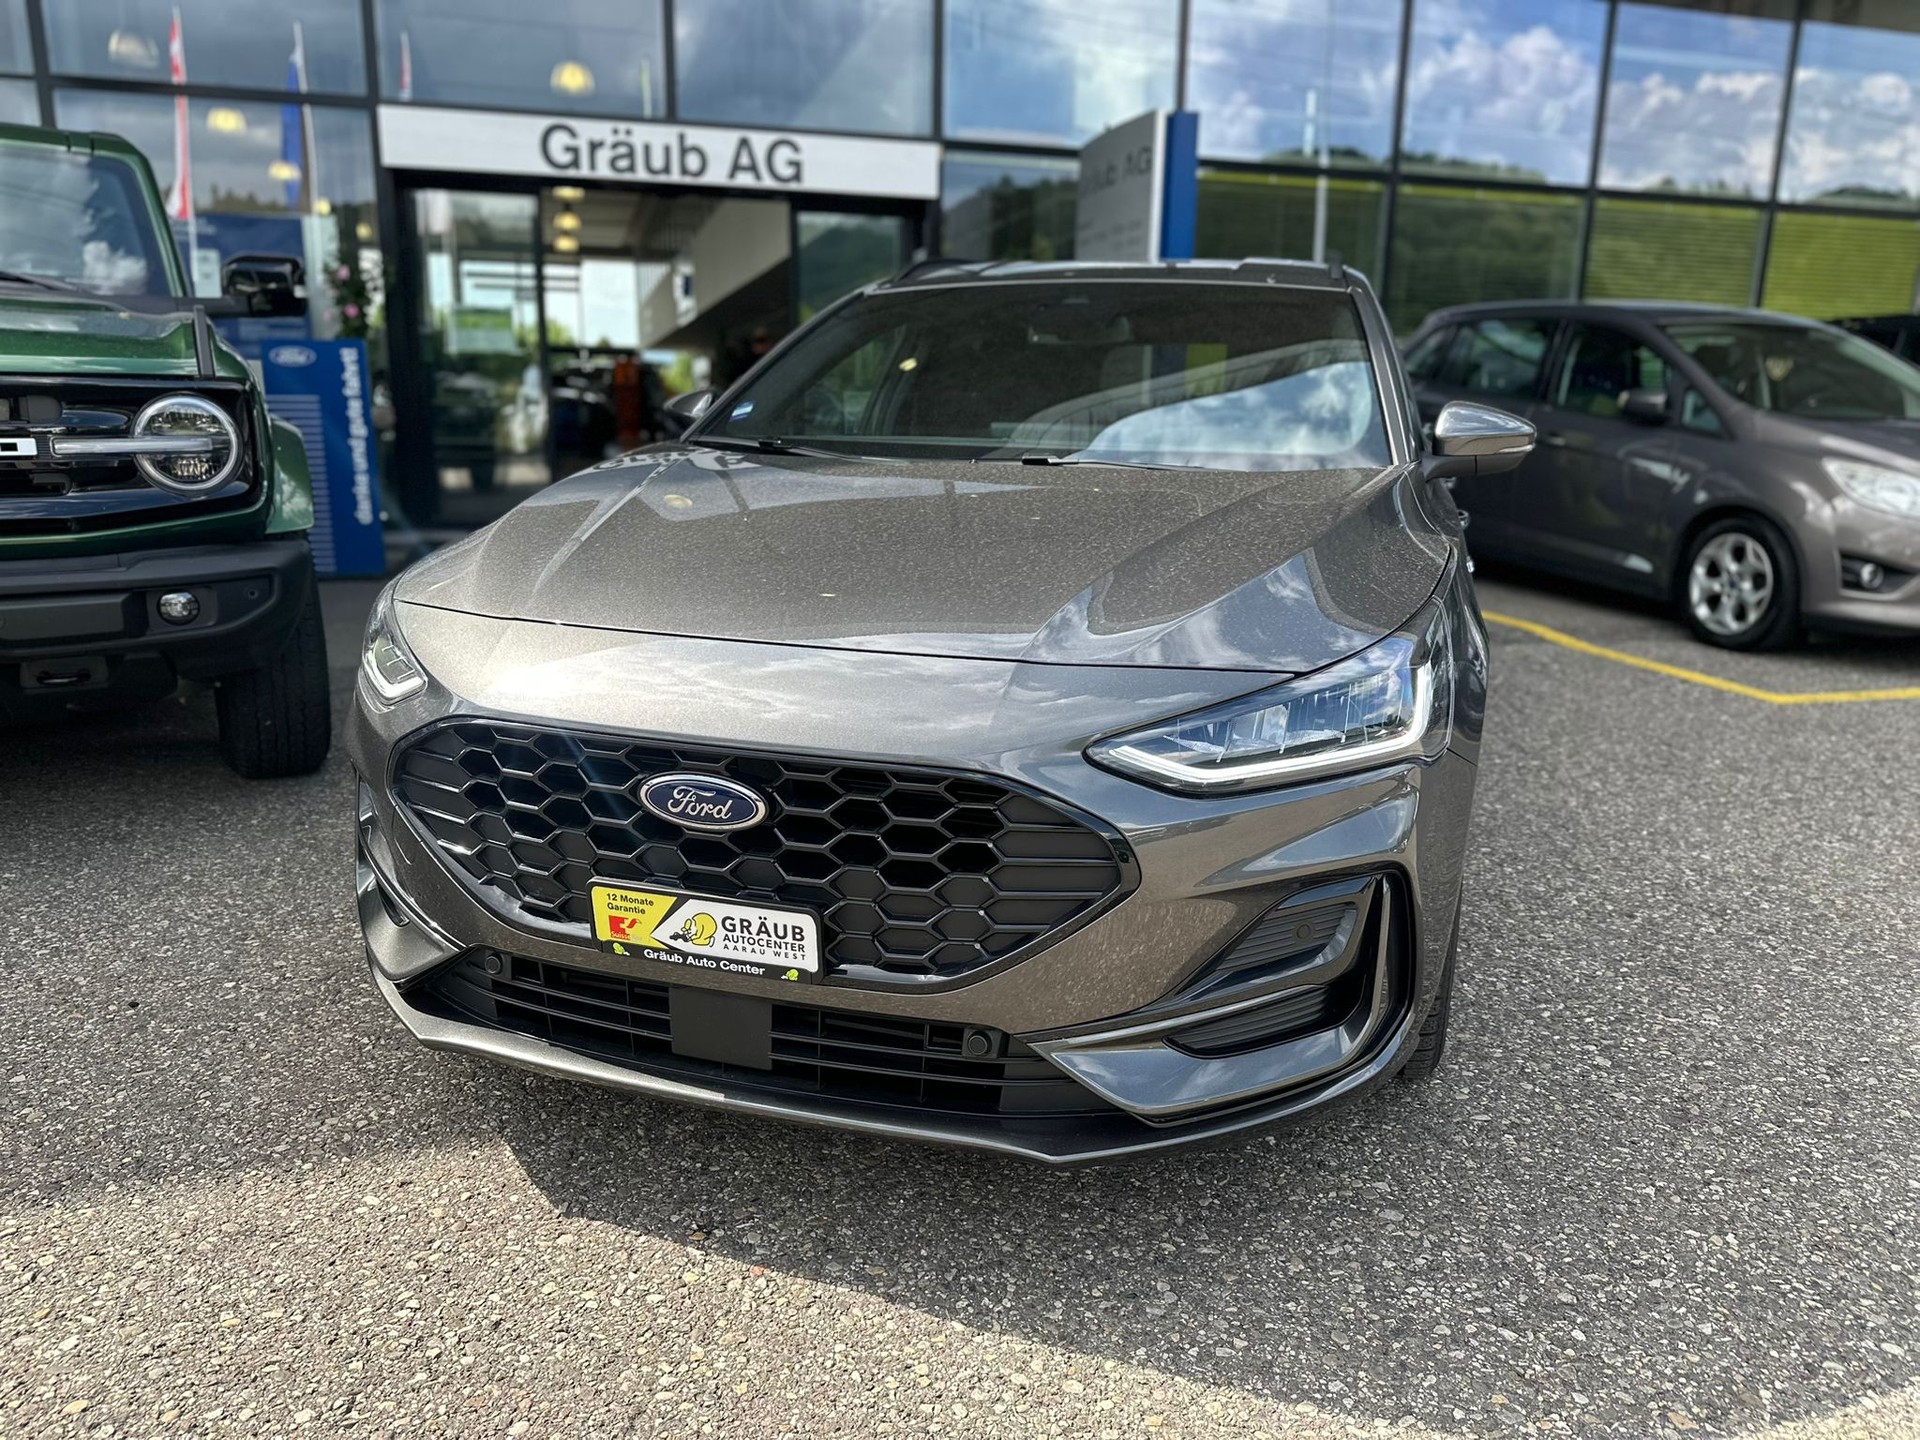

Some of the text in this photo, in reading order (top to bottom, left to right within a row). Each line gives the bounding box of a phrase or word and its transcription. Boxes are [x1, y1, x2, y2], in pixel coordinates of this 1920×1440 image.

[540, 123, 804, 184] Gräub AG
[667, 785, 733, 820] Ford
[606, 893, 654, 907] 12 Monate
[607, 902, 646, 915] Garantie
[721, 915, 805, 942] GRÄUB
[723, 933, 806, 953] AUTOCENTER
[723, 943, 806, 961] AARAU WEST
[643, 948, 765, 975] Gräub Auto Center
